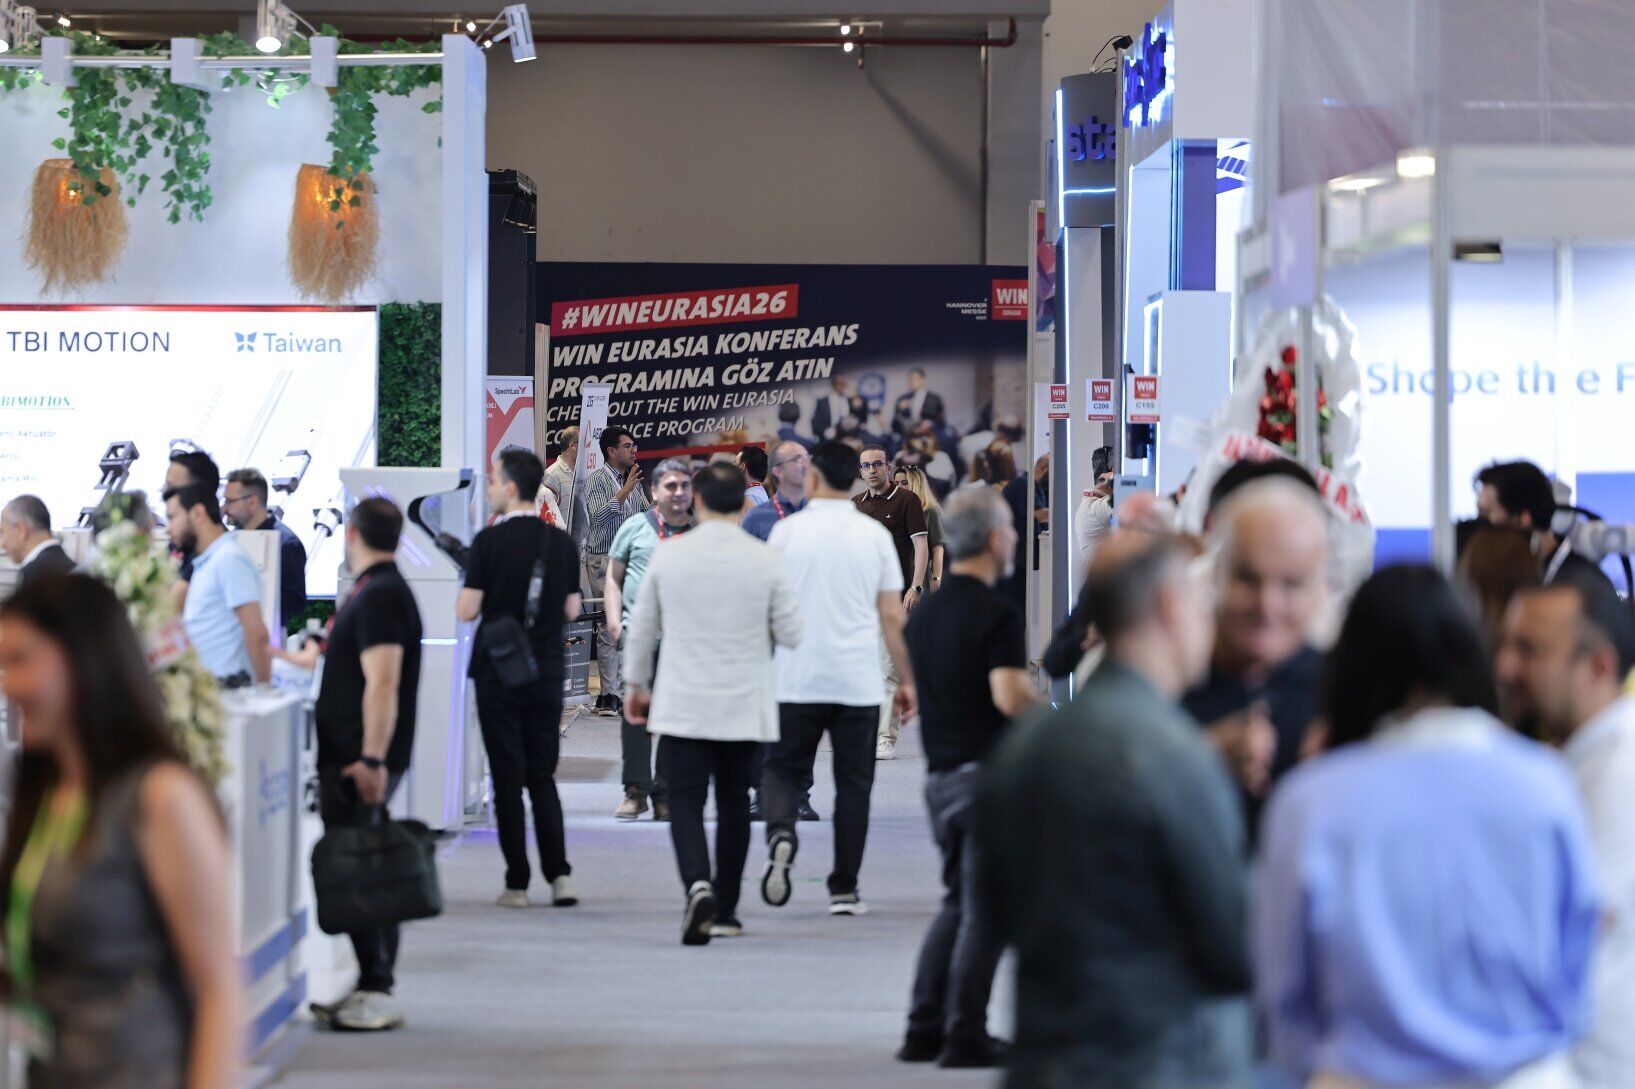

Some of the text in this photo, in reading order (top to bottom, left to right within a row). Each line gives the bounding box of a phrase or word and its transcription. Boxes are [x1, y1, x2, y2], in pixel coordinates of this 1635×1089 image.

[996, 288, 1028, 305] WIN
[561, 291, 788, 329] #WINEURASIA26
[6, 331, 170, 352] TBI MOTION
[263, 332, 342, 352] Taiwan
[552, 323, 860, 368] WIN EURASIA KONFERANS
[721, 358, 771, 386] GÖZ
[775, 357, 834, 382] ATIN
[1052, 388, 1065, 396] WIN
[1094, 385, 1109, 394] WIN
[1136, 380, 1154, 391] WIN
[607, 399, 647, 418] OUT
[647, 396, 678, 415] THE
[682, 393, 719, 412] WIN
[722, 388, 795, 408] EURASIA
[656, 416, 745, 437] PROGRAM
